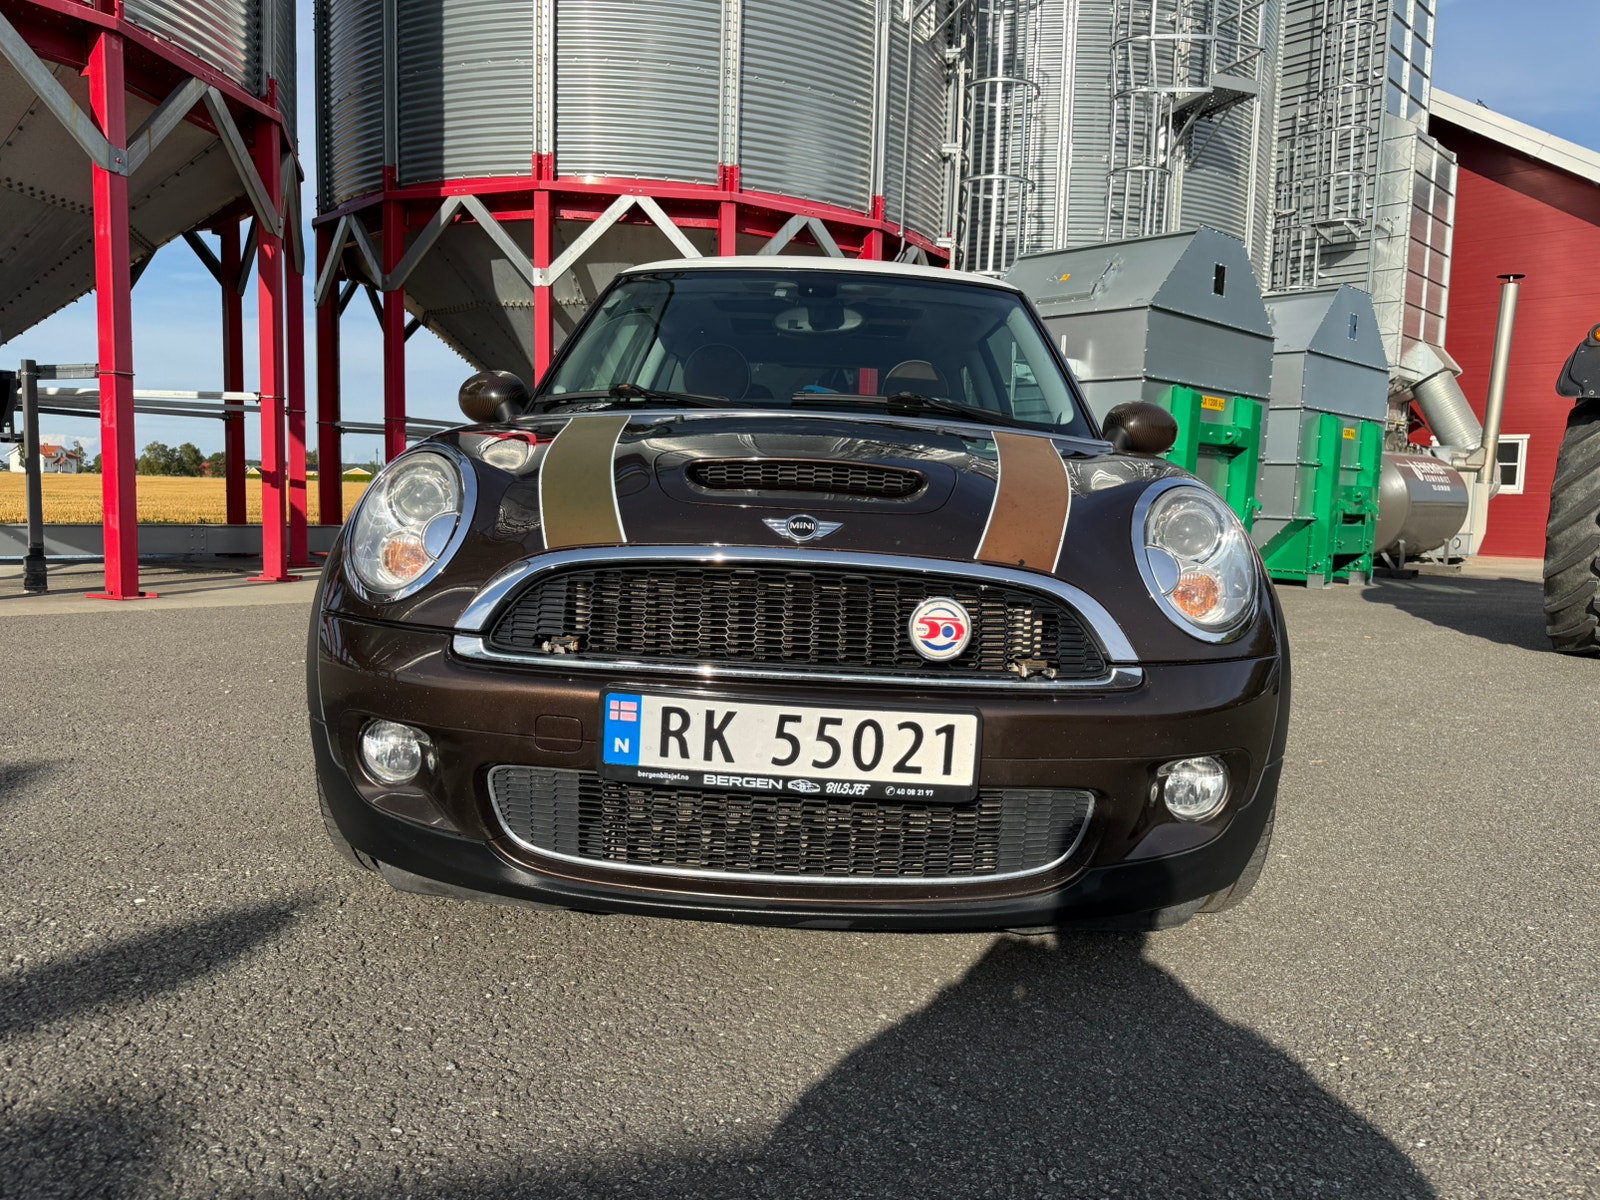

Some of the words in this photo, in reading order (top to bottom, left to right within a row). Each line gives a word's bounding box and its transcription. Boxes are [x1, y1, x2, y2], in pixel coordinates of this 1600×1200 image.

[789, 521, 816, 531] MINI
[614, 737, 630, 754] N
[659, 705, 738, 763] RK
[770, 714, 957, 776] 55021
[637, 770, 690, 781] bergenbilsjef.no
[703, 773, 783, 790] BERGEN
[825, 781, 871, 796] BILSJEF
[925, 789, 934, 797] 97
